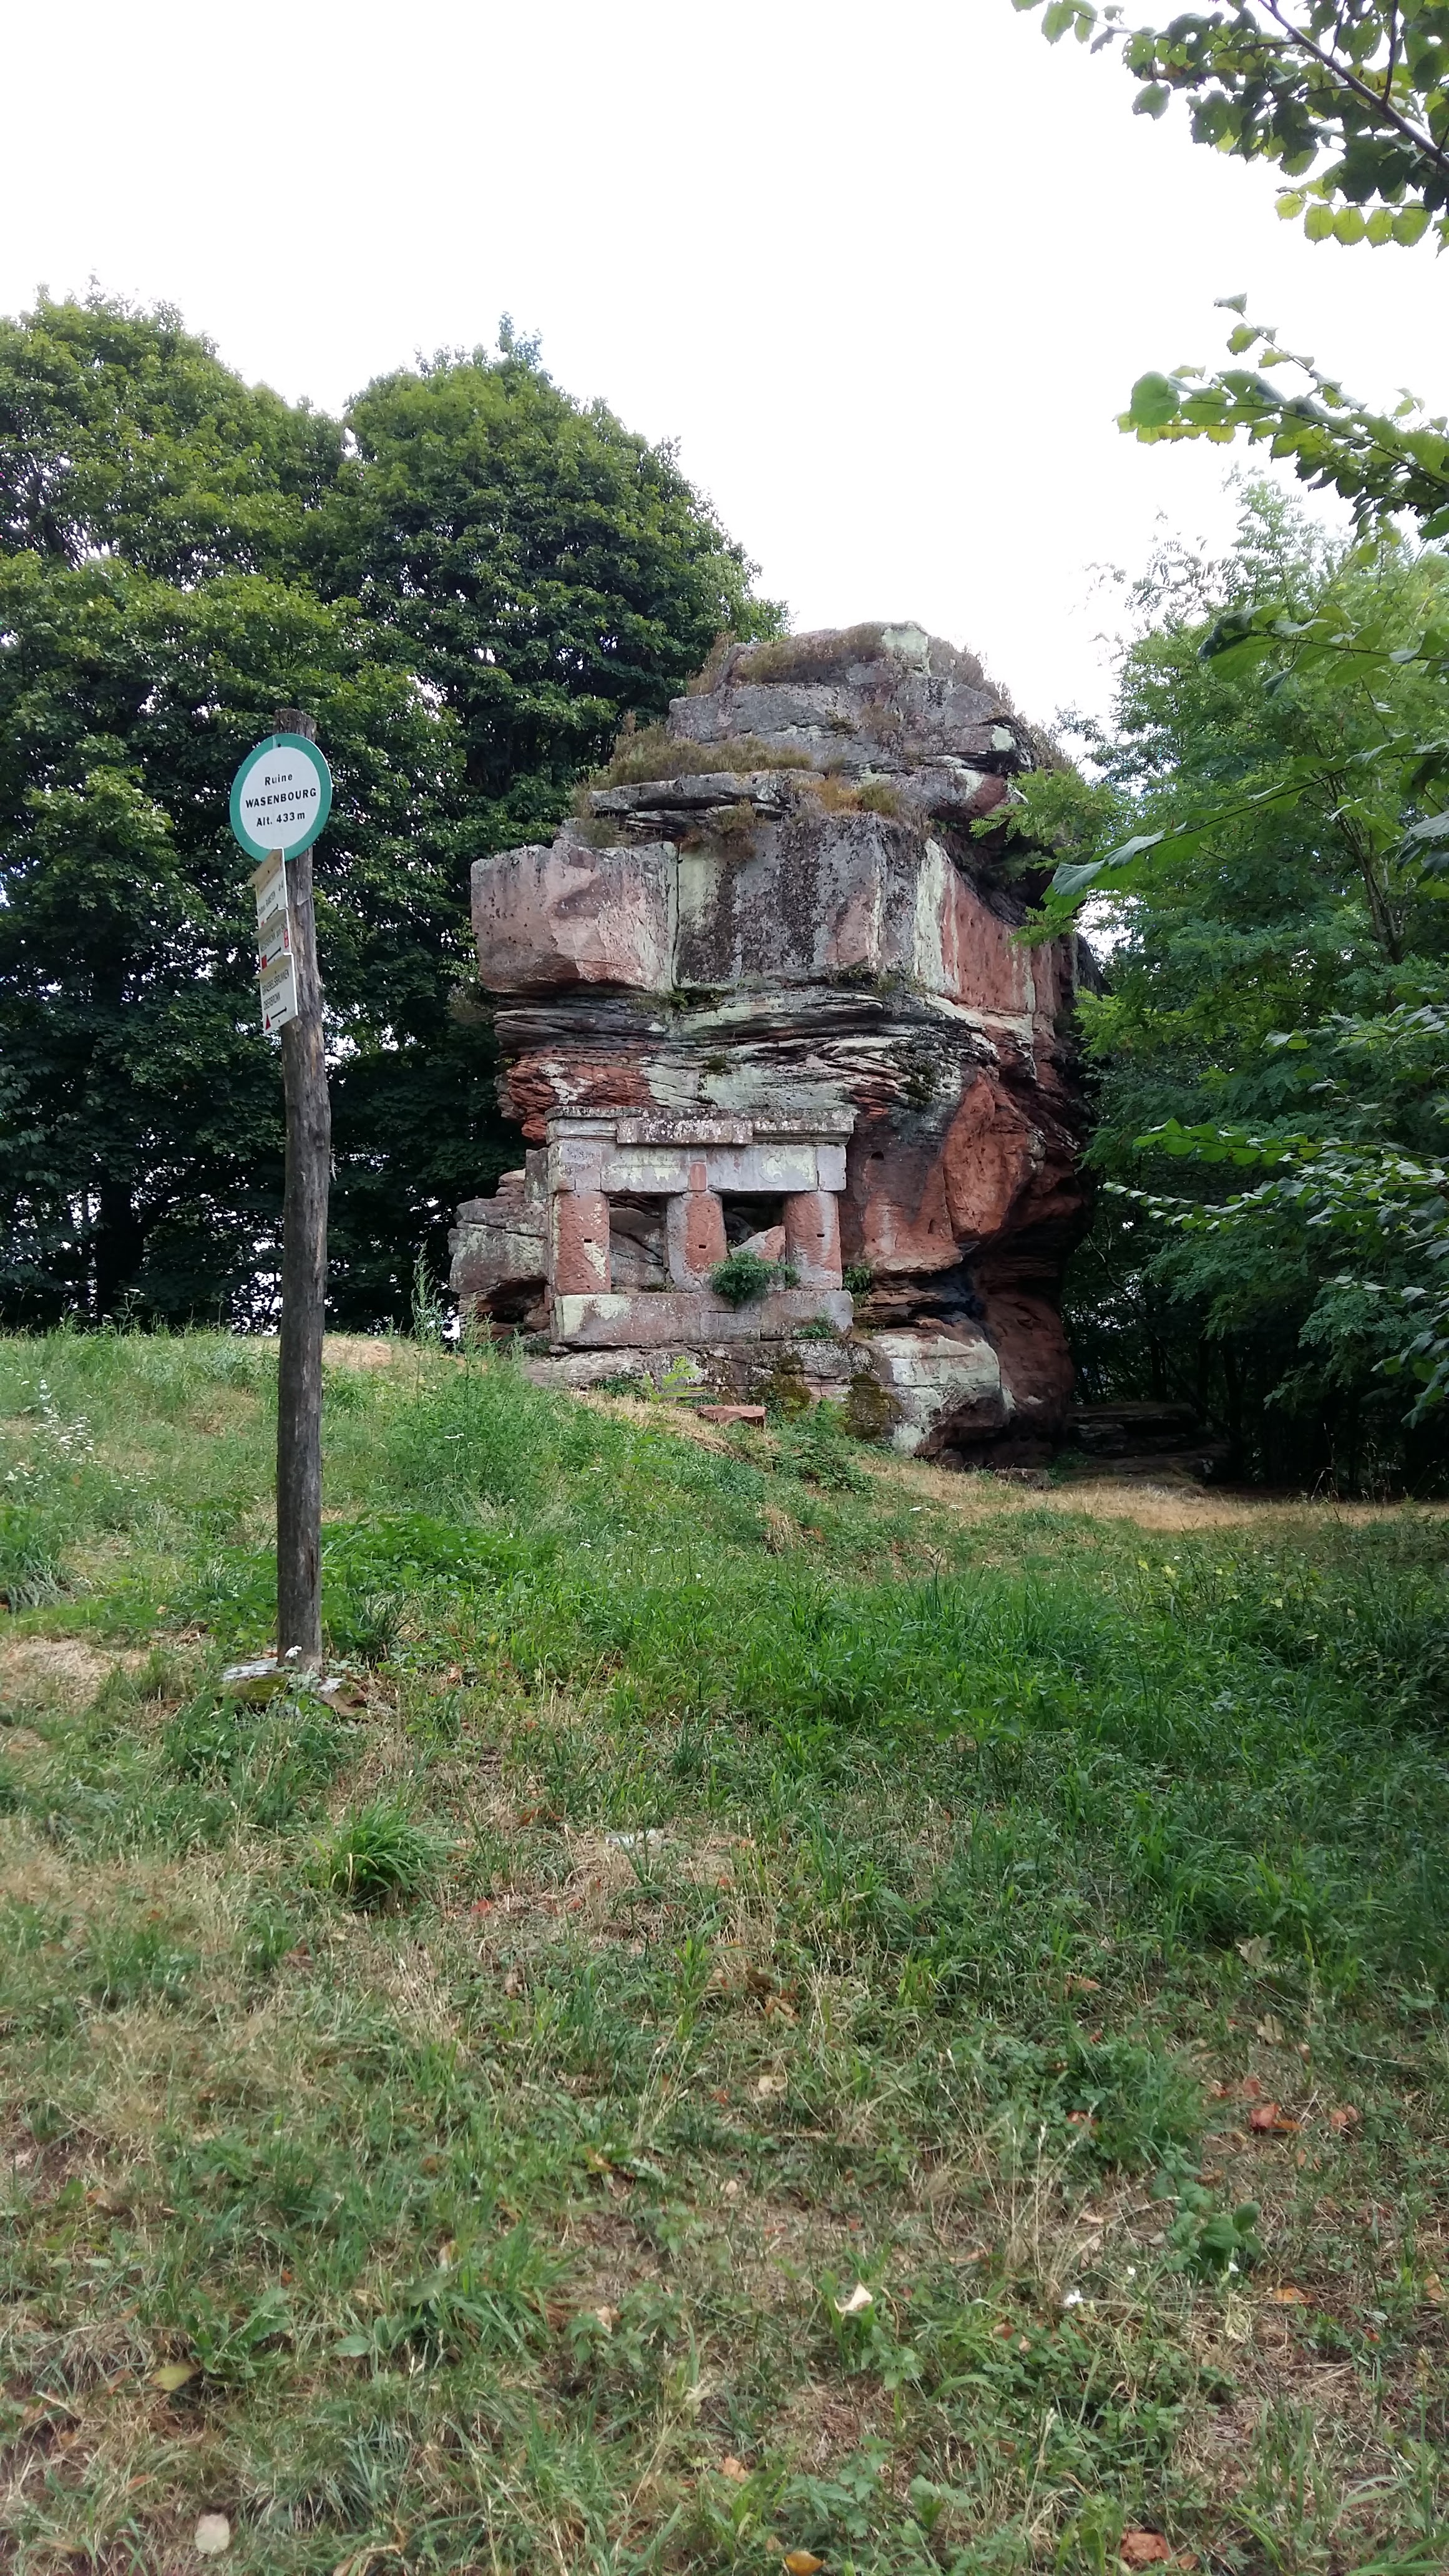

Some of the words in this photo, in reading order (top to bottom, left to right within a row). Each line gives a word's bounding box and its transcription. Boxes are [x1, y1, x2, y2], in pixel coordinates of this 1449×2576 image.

[265, 774, 293, 786] Ruine
[245, 788, 316, 808] WASENBOURG
[256, 817, 273, 827] Alt.
[276, 812, 295, 823] 433
